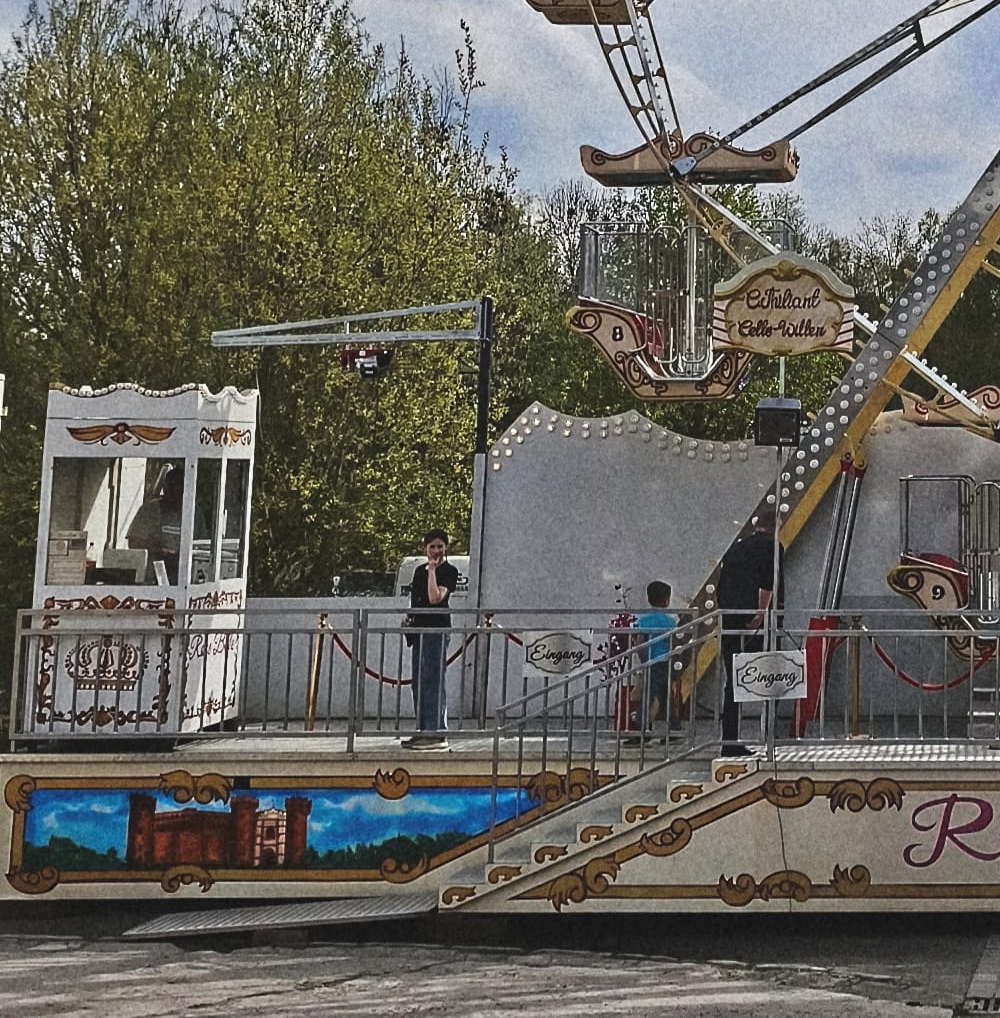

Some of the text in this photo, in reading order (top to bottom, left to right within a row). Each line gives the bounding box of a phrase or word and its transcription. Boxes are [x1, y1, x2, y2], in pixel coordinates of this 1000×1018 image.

[612, 325, 624, 342] 8
[931, 584, 946, 601] 9
[530, 644, 585, 665] Eingang
[741, 666, 798, 688] Eingang
